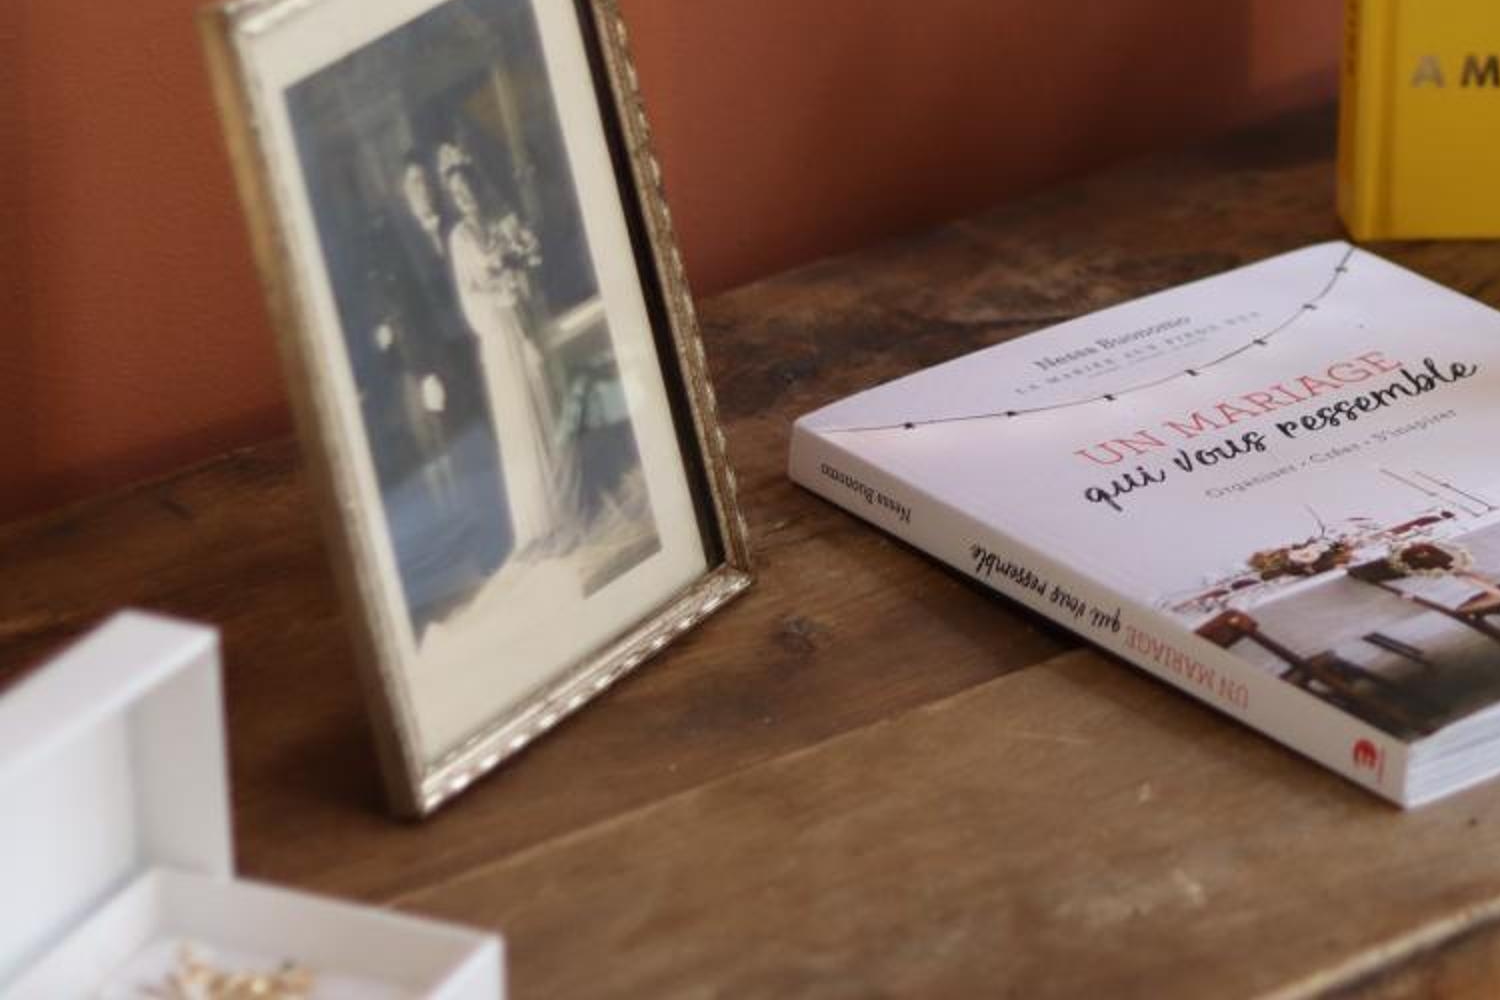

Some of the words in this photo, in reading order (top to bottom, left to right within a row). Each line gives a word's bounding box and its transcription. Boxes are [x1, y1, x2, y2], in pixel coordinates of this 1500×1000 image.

[1074, 429, 1167, 468] UN
[1163, 351, 1404, 439] MARIAGE
[1084, 465, 1166, 512] qui
[1172, 431, 1267, 473] vous
[1276, 357, 1479, 439] ressemble
[971, 544, 1047, 597] ressemble
[1049, 585, 1088, 618] vous
[1089, 607, 1122, 633] qui
[1123, 624, 1217, 688] MARIAGE
[1216, 669, 1250, 710] UN
